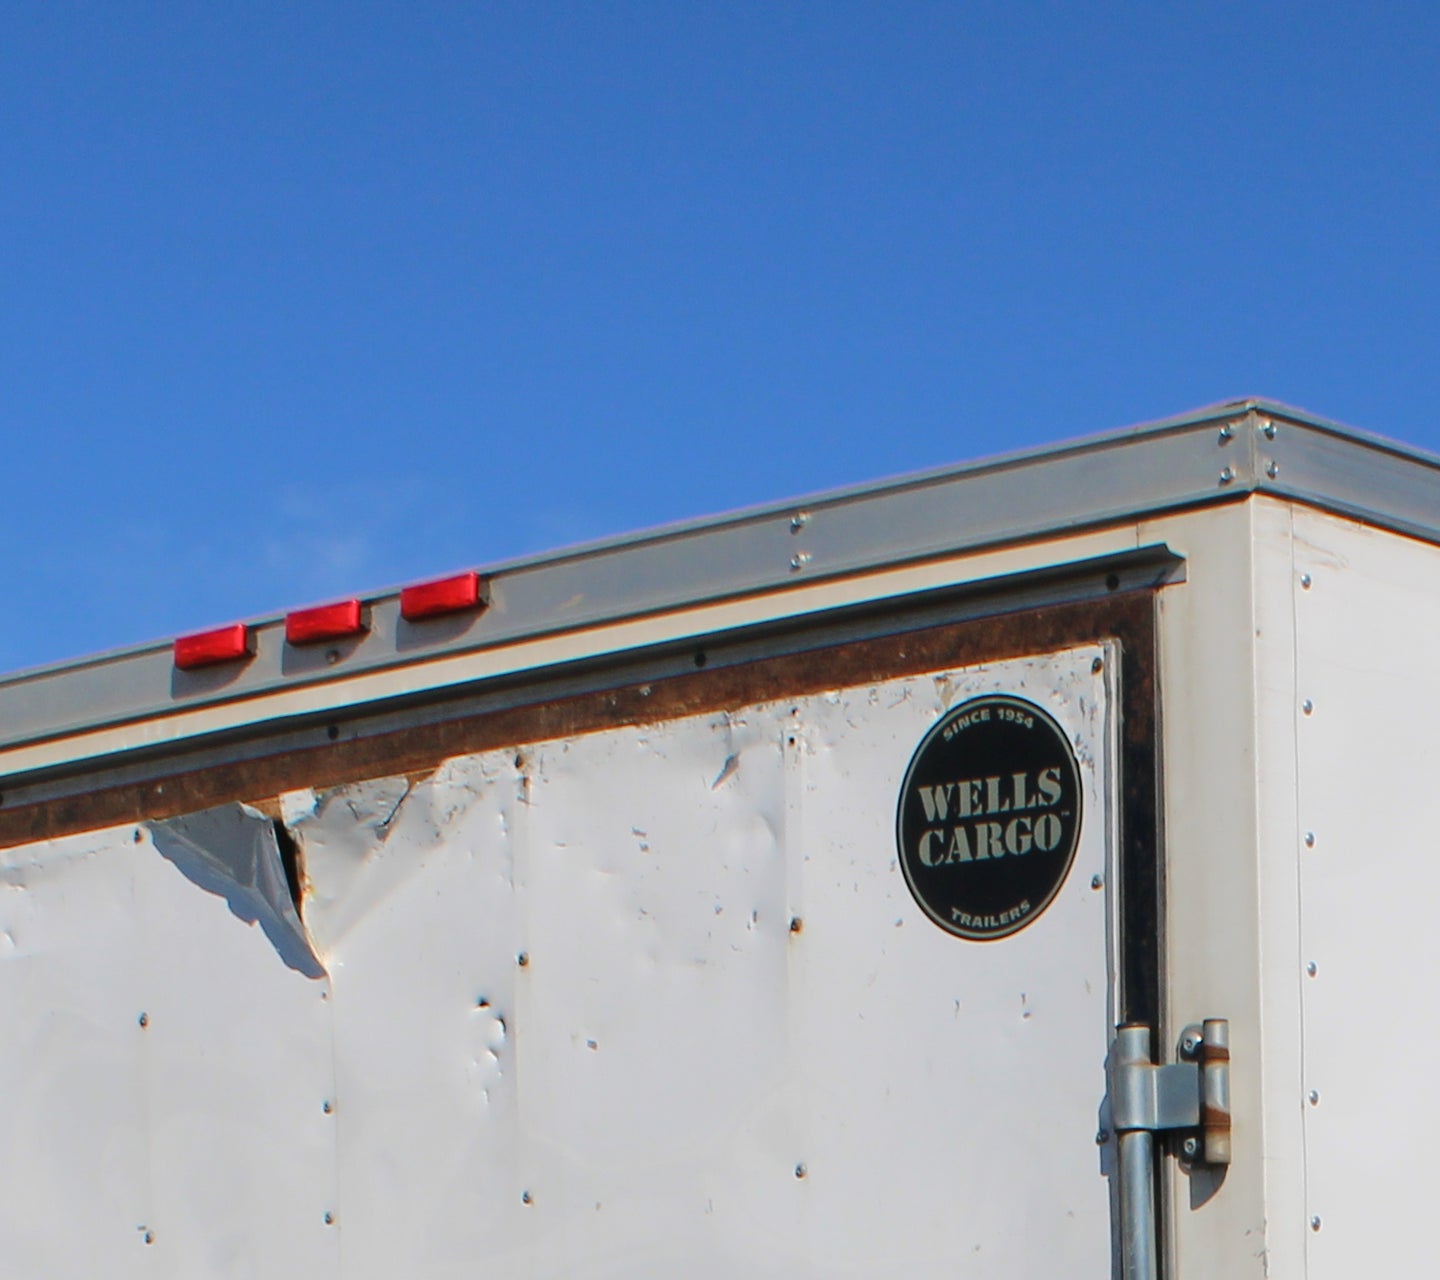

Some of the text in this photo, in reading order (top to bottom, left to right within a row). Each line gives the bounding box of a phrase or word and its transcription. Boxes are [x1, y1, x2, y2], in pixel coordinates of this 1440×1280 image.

[943, 708, 1035, 742] SINCE 1954
[918, 767, 1063, 823] WELLS
[918, 813, 1063, 868] CARGO
[951, 899, 1031, 928] TRAILERS
